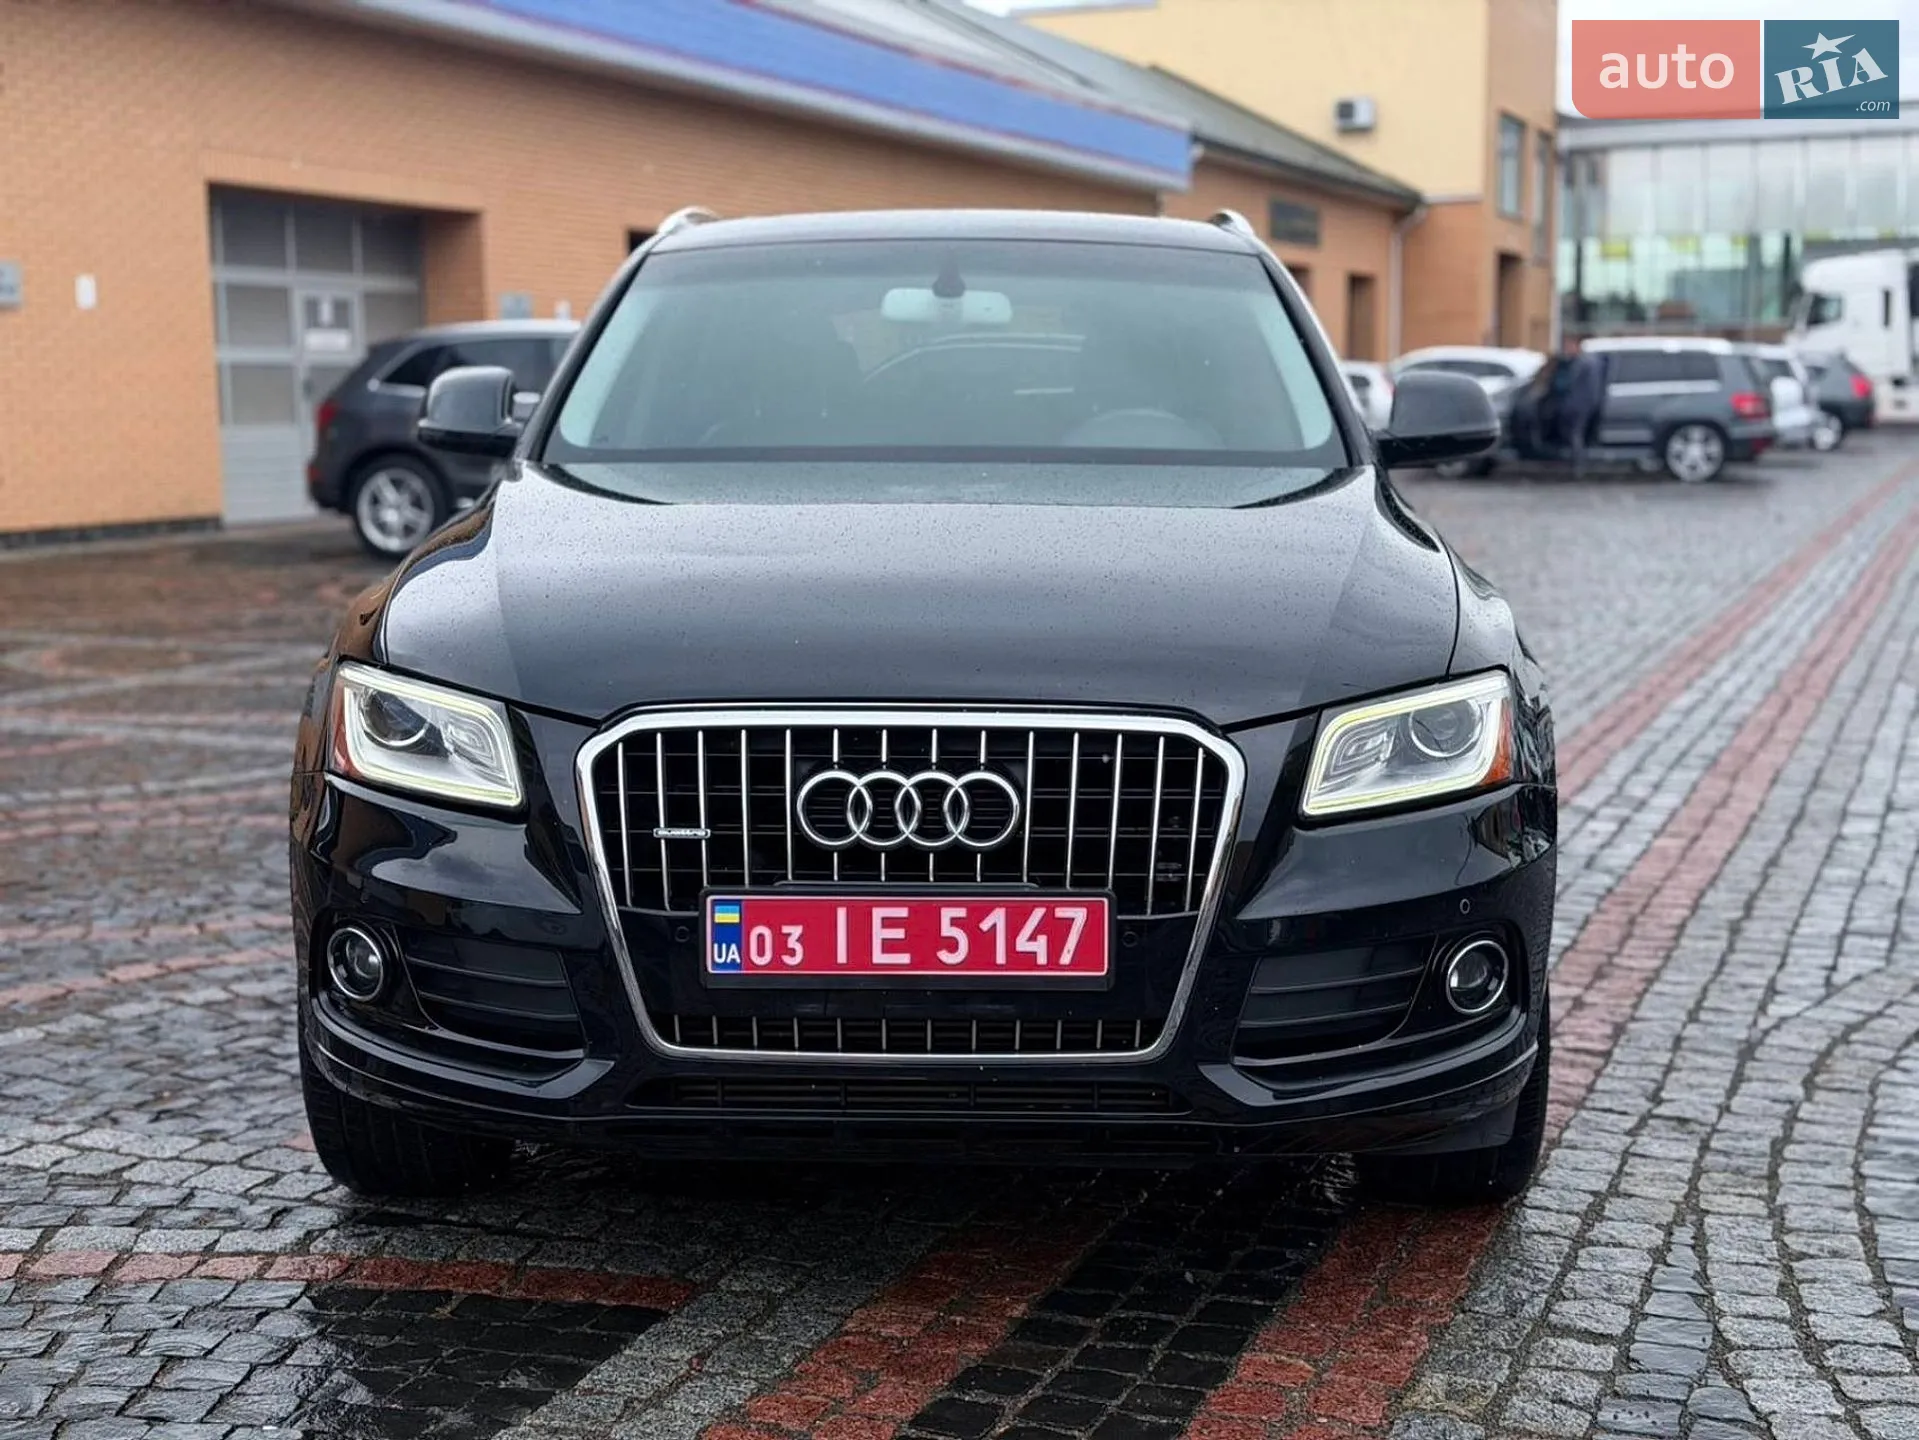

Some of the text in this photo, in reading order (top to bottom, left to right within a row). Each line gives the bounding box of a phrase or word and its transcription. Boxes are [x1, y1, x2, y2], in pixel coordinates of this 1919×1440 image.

[713, 943, 741, 964] UA
[748, 907, 1088, 966] 03 IE 5147
